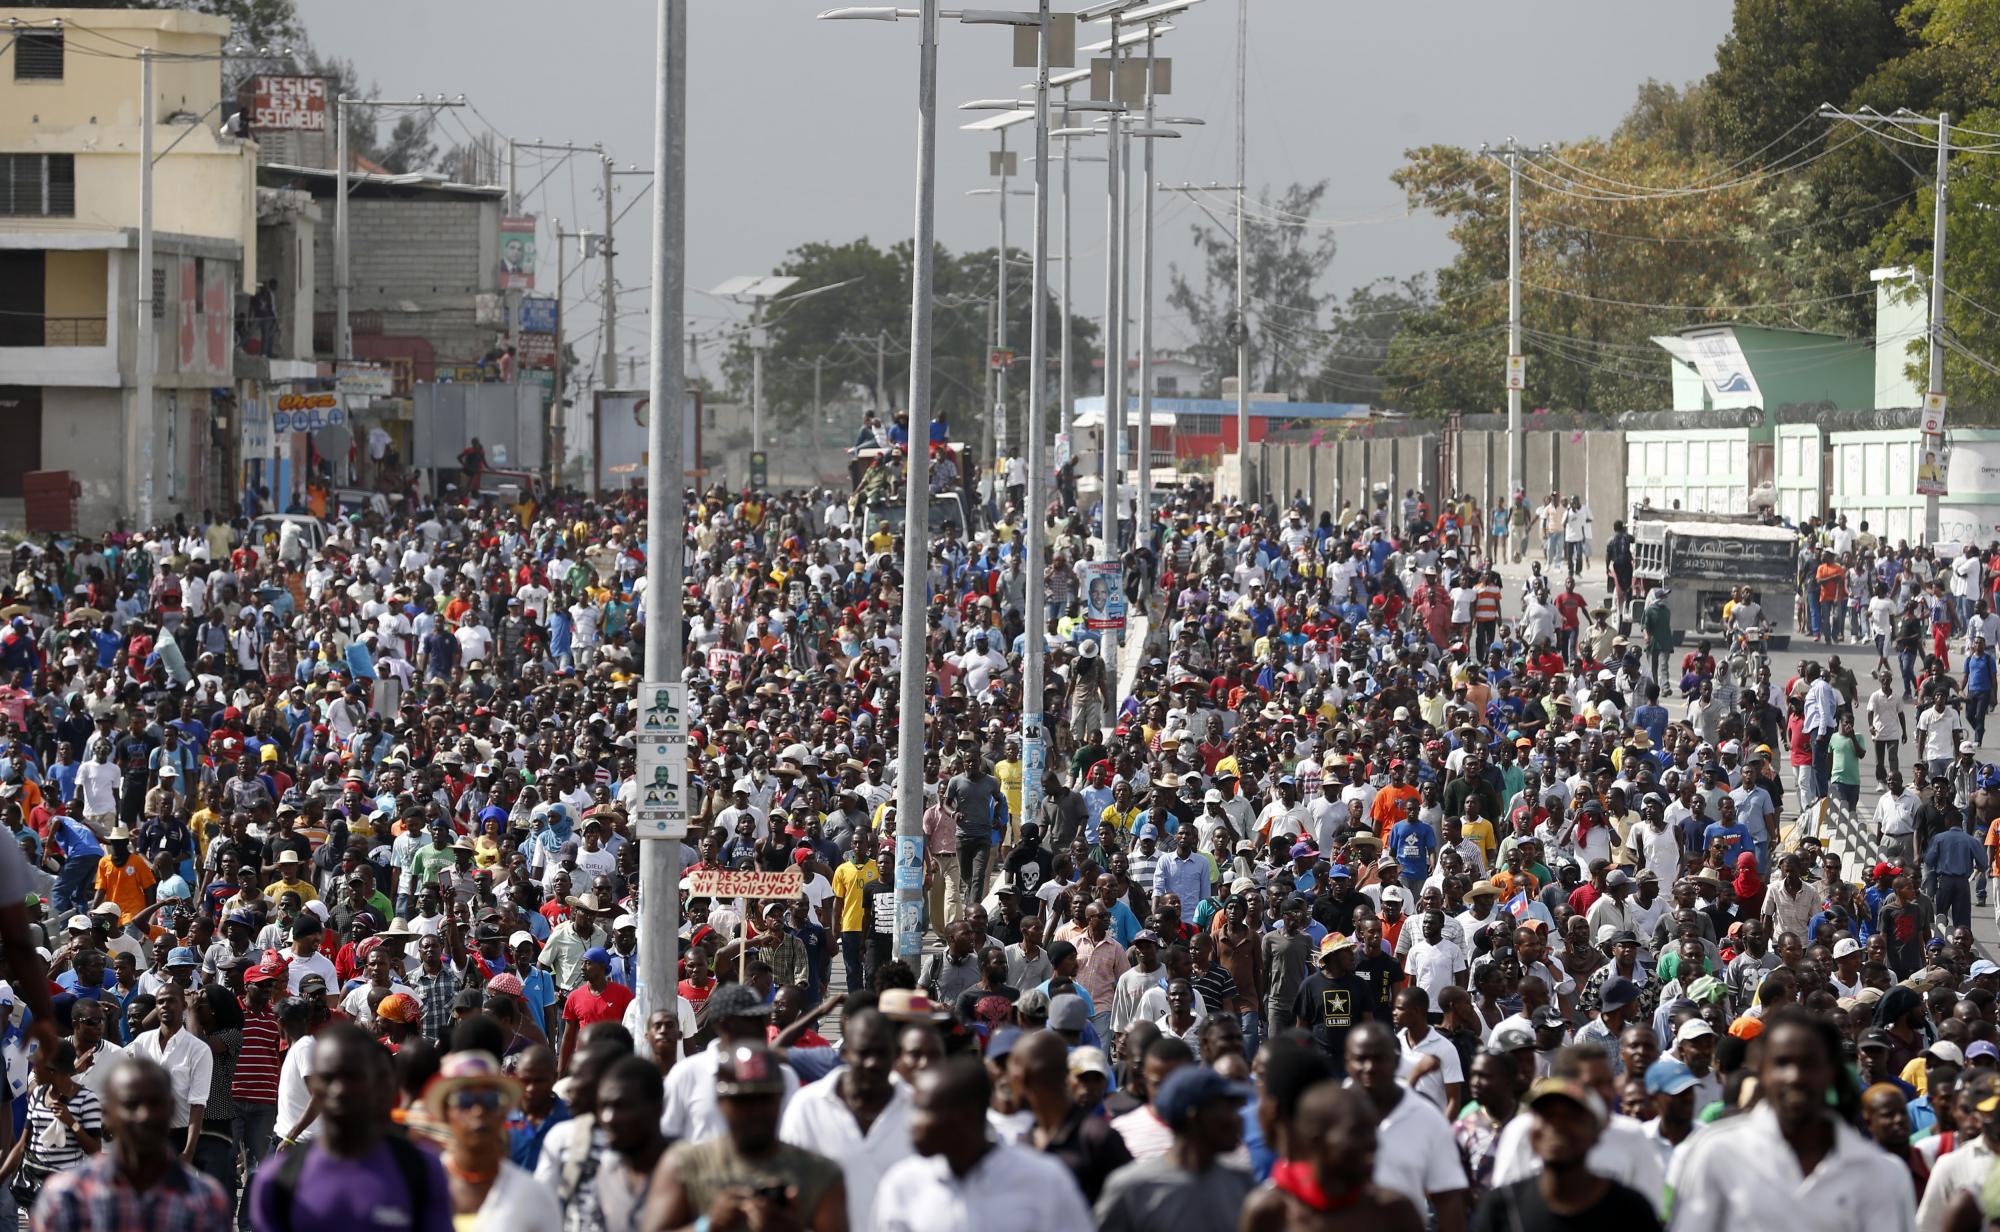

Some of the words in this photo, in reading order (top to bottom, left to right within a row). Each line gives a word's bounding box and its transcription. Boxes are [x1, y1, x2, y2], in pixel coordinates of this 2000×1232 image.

[256, 77, 324, 96] JESUS
[270, 95, 309, 110] EST
[249, 108, 324, 129] SEIGNEUR
[273, 408, 345, 433] POLO
[856, 878, 865, 889] 10
